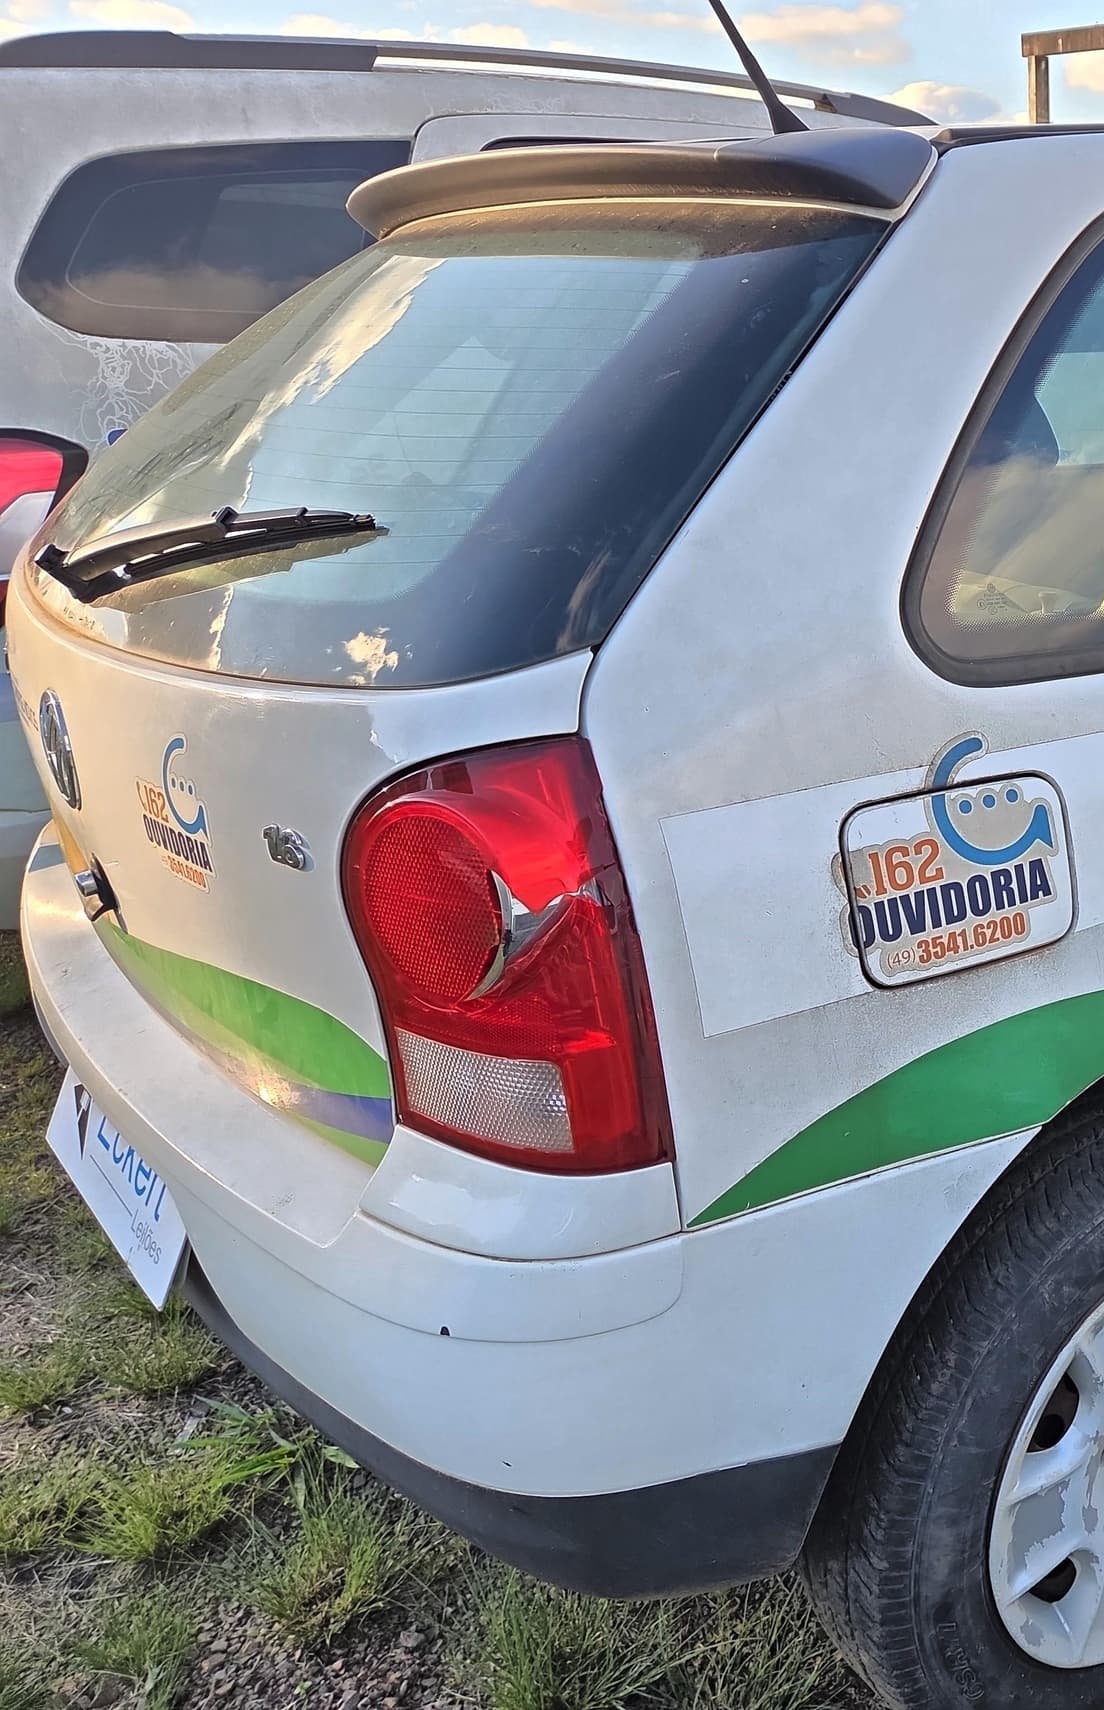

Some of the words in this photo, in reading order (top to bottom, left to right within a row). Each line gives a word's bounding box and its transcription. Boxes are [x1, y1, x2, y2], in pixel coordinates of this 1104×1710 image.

[144, 784, 169, 823] 162
[142, 813, 213, 873] OUVIDORIA
[868, 838, 944, 896] 162
[848, 857, 1052, 950] OUVIDORIA
[887, 948, 916, 970] (49)
[917, 911, 1026, 965] 3541.6200
[131, 1208, 162, 1265] Leilões
